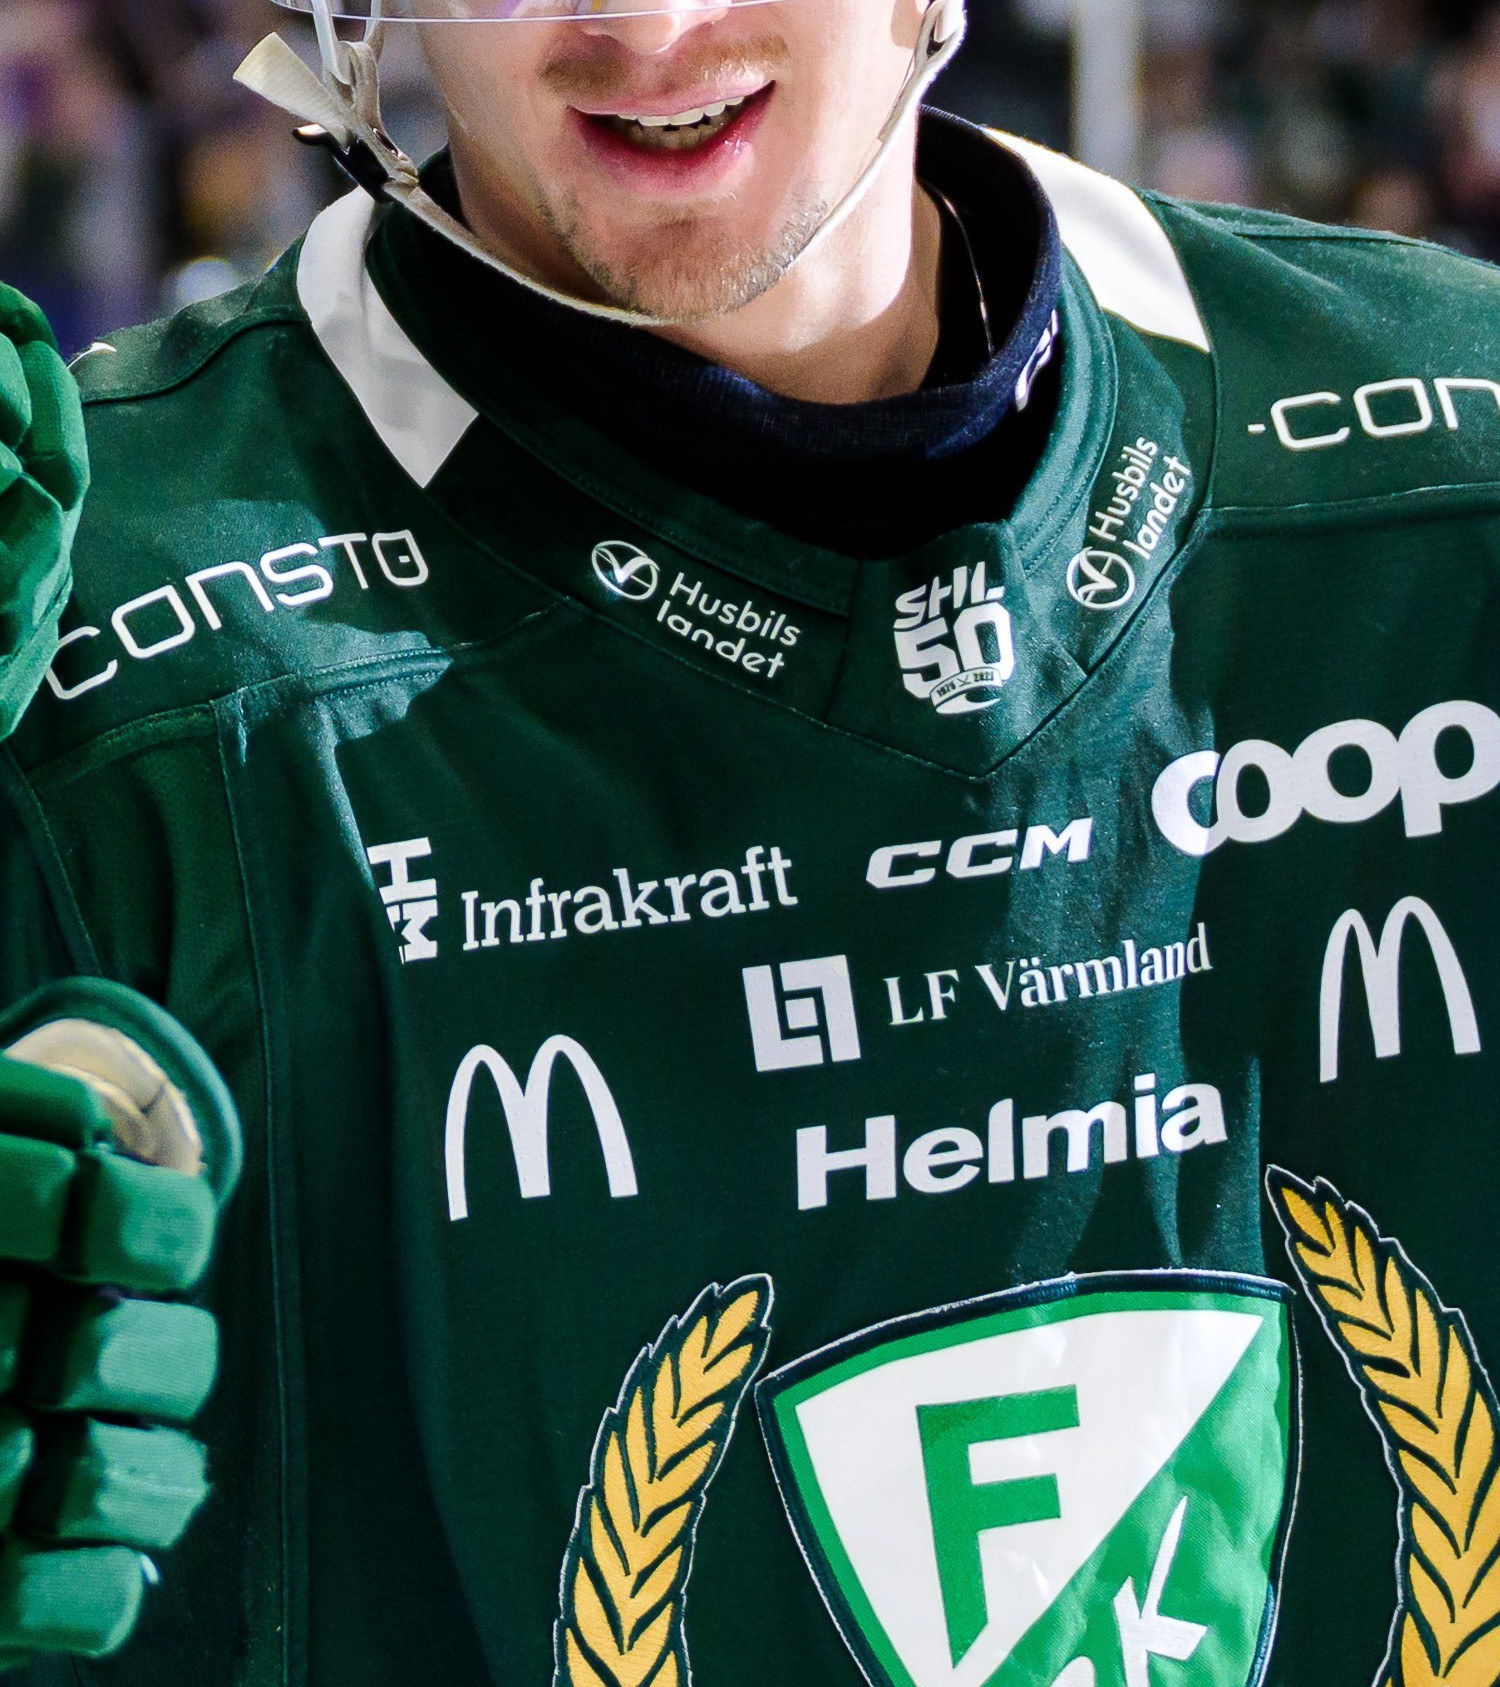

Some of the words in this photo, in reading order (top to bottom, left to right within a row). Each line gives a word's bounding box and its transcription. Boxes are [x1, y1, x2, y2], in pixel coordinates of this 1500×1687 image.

[1089, 435, 1159, 541] Husbils
[1123, 455, 1191, 561] landet
[657, 600, 786, 680] landet
[670, 572, 802, 647] Husbils
[893, 561, 1005, 629] SHL
[894, 601, 1015, 700] 50
[461, 844, 799, 952] Infrakraft
[865, 817, 1094, 889] CCM
[883, 968, 959, 1026] LF
[974, 922, 1214, 1012] Värmland
[796, 1072, 1228, 1211] Helmia
